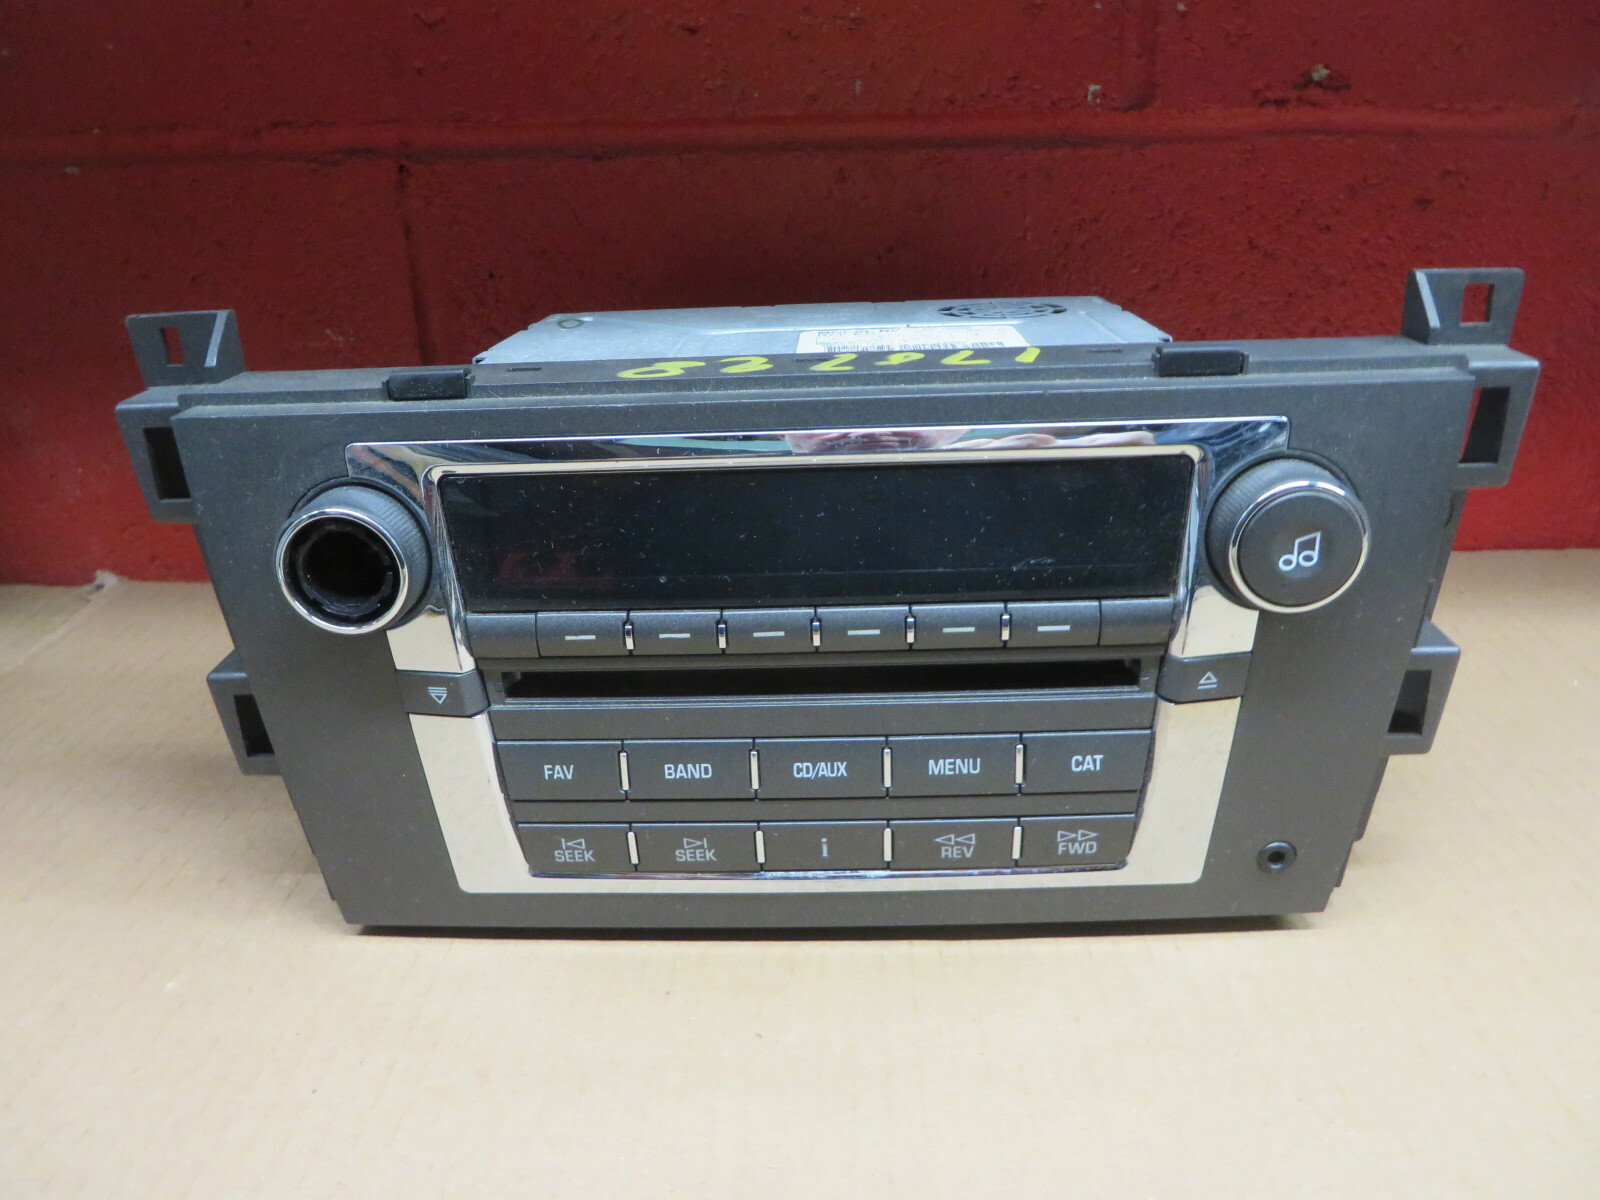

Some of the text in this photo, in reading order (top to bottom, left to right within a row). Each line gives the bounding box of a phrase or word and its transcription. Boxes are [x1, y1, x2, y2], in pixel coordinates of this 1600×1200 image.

[664, 763, 713, 779] BAND
[793, 761, 848, 779] CD/AUX
[928, 758, 981, 775] MENU
[1071, 755, 1104, 772] CAT
[543, 764, 575, 780] FAV
[554, 849, 596, 862] SEEK
[675, 849, 717, 862] SEEK
[941, 845, 974, 859] REV
[1058, 841, 1097, 855] FWD
